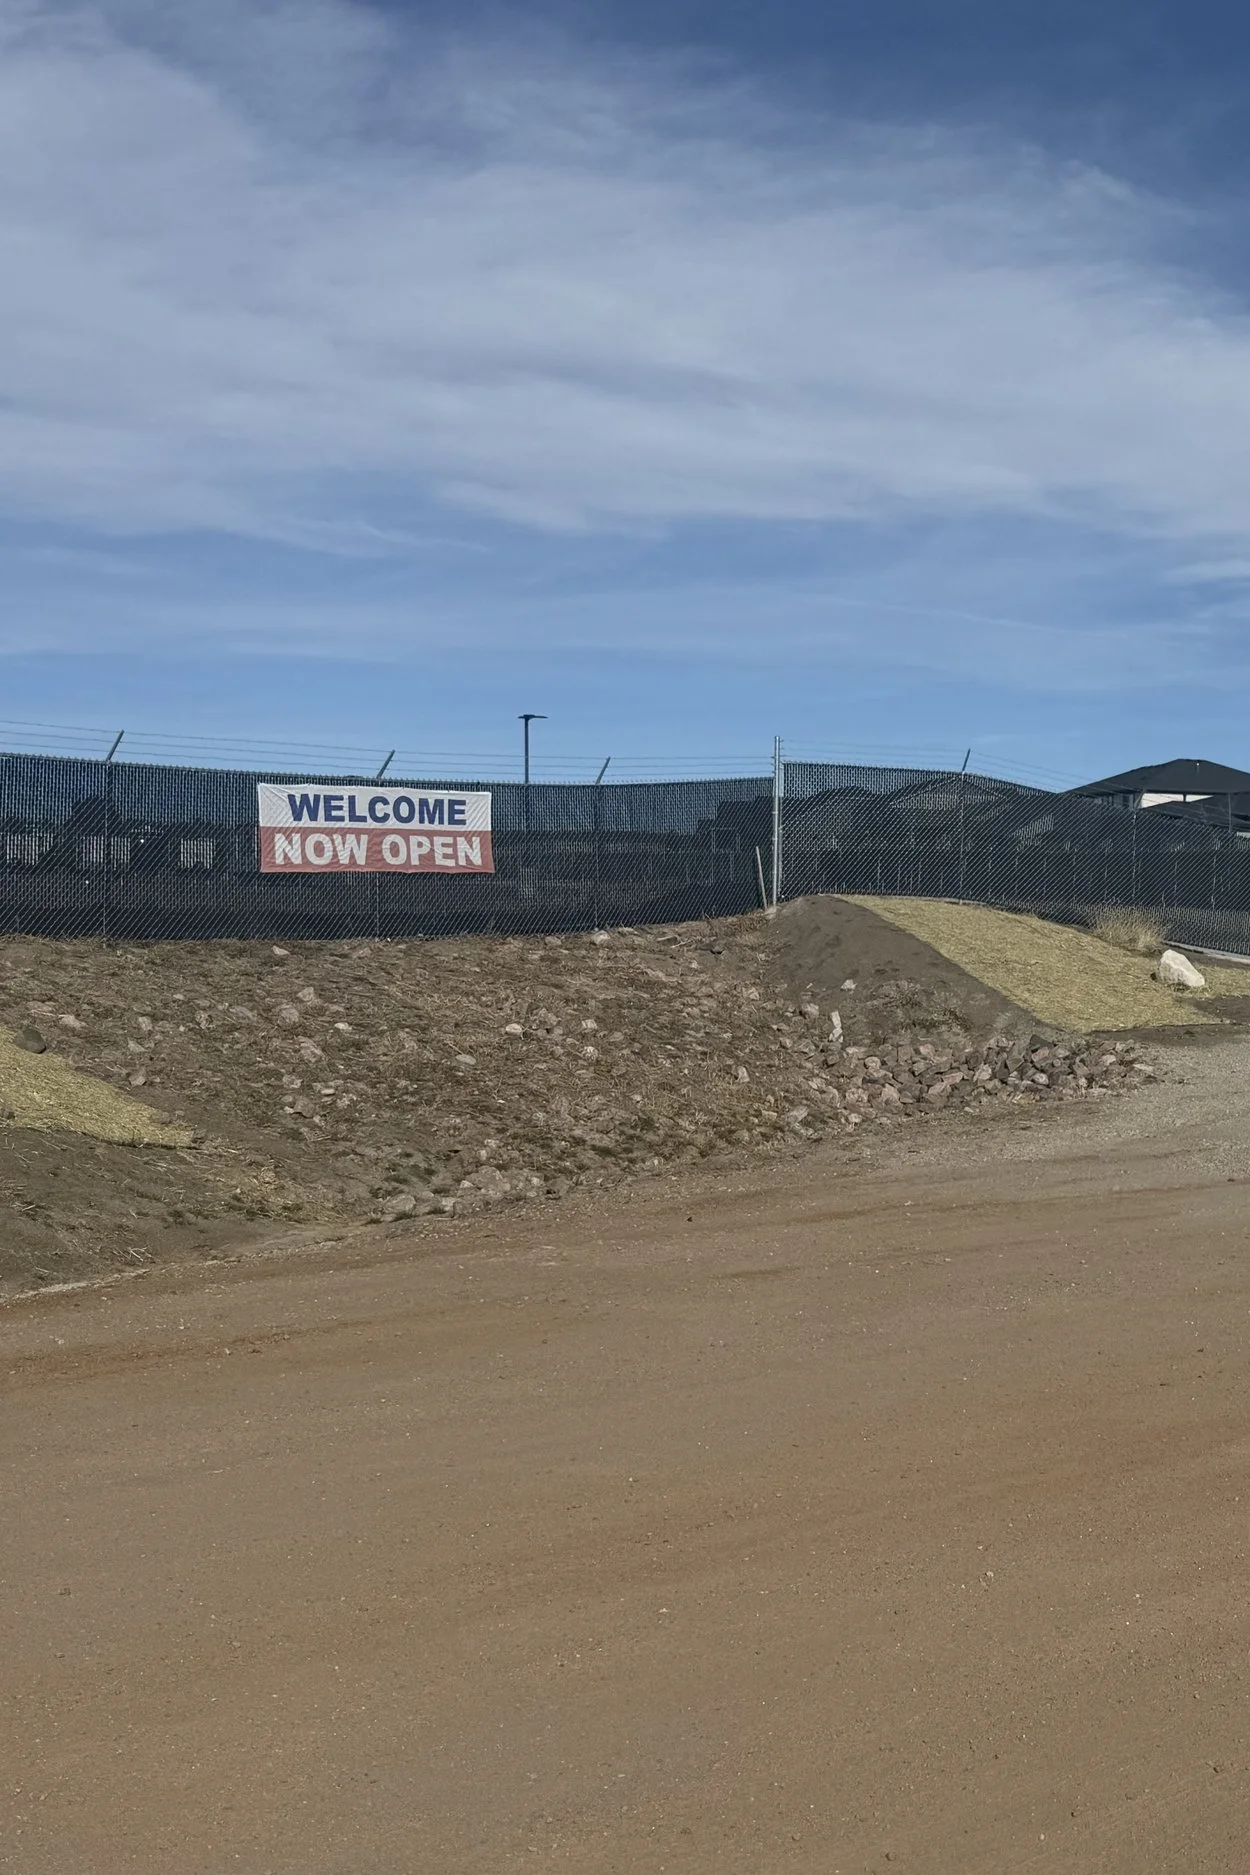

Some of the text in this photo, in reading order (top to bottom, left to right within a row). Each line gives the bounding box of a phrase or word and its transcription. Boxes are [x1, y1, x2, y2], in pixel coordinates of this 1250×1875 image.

[287, 793, 468, 826] WELCOME
[273, 832, 483, 867] NOW OPEN
